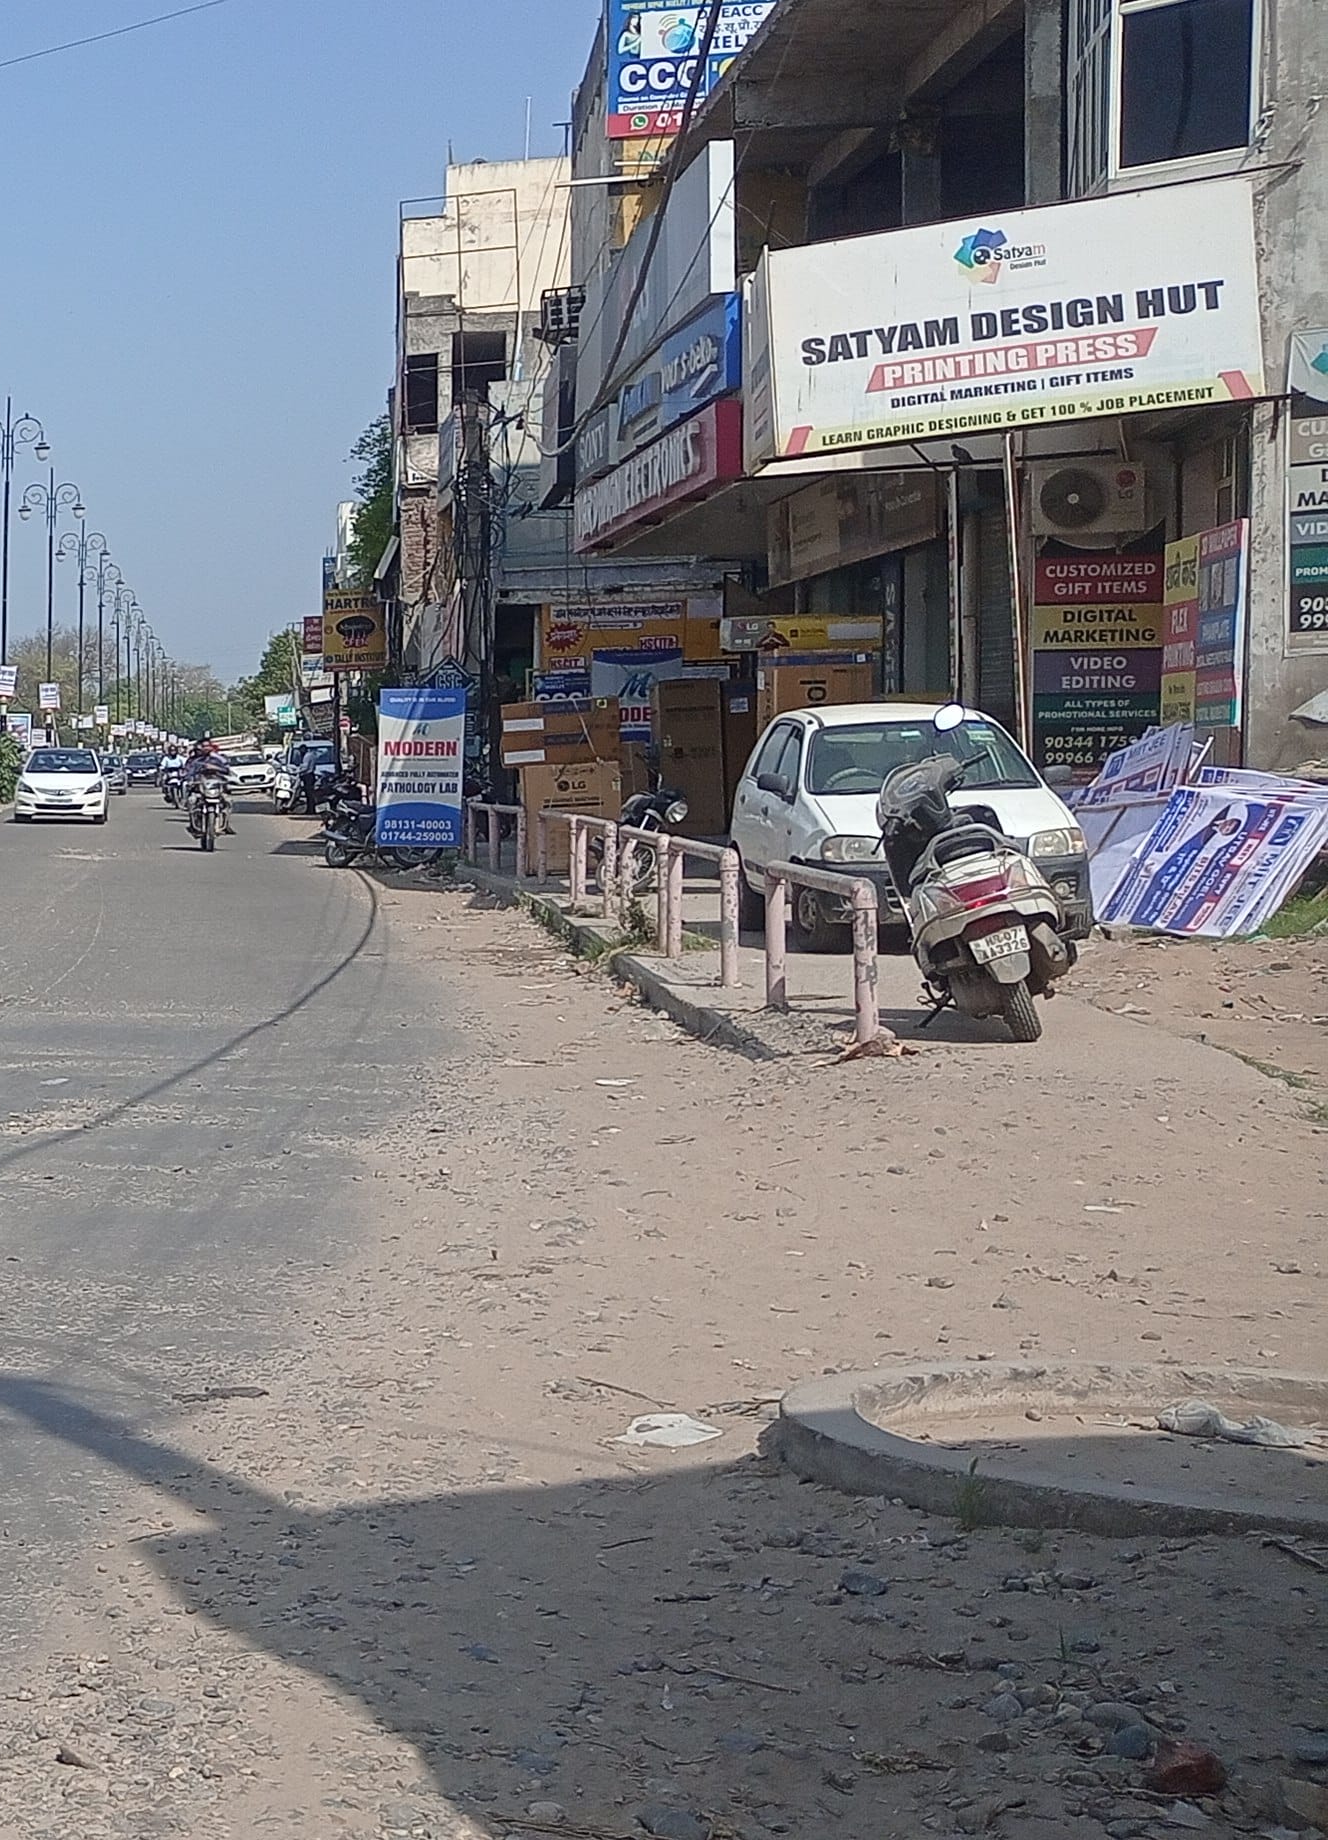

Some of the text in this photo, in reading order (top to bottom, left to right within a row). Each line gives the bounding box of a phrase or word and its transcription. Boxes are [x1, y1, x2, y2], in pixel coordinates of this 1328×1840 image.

[993, 244, 1046, 260] Satyam
[801, 279, 1225, 366] SATYAM DESIGN HUT
[883, 333, 1138, 388] PRINTING PRESS
[890, 366, 1134, 409] DIGITAL MARKETING GIFT ITEMS
[822, 386, 1215, 446] LEARN GRAPHIC DESIGNING & GET 100 % JOB PLACEMENT
[1045, 563, 1156, 578] CUSTOMIZED
[1054, 581, 1147, 595] GIFT ITEMS
[1063, 609, 1137, 623] DIGITAL
[1043, 629, 1156, 643] MARKETING
[1070, 656, 1127, 670] VIDEO
[1061, 675, 1136, 689] EDITING
[1085, 700, 1115, 708] TYPES
[1038, 710, 1157, 719] PROMOTIONAL SERVICES
[384, 741, 458, 756] MODERN
[1045, 736, 1094, 748] 90344
[1045, 752, 1094, 764] 99966
[381, 782, 458, 794] PATHOLOGY LAB
[571, 780, 587, 789] LG
[384, 819, 451, 830] 98131-40003
[380, 831, 454, 841] 01744-259003
